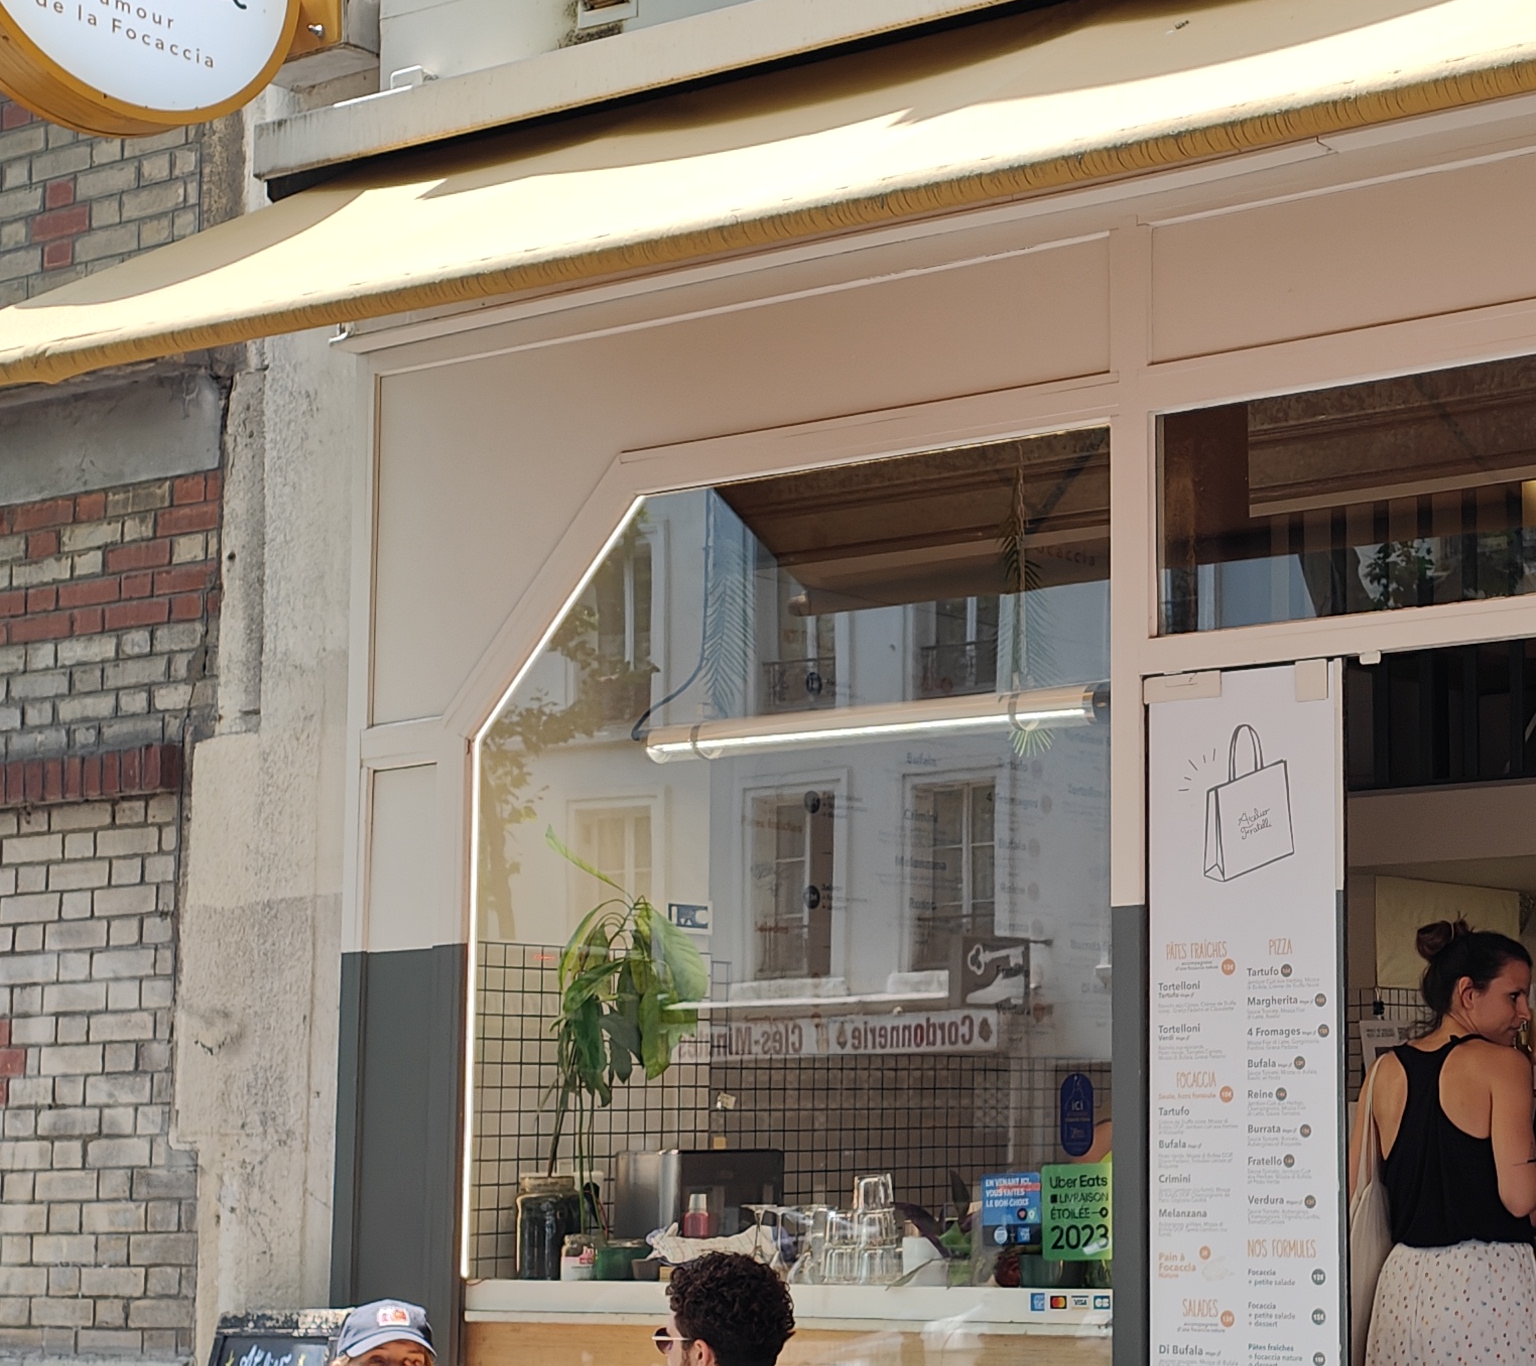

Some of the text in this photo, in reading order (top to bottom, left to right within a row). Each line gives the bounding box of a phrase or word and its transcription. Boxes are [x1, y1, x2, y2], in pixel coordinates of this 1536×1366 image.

[77, 4, 98, 27] la
[111, 18, 216, 69] Focaccia
[1166, 938, 1228, 961] PÂTES FRAÎCHES
[1269, 938, 1292, 956] PIZZA
[1247, 966, 1279, 977] Tartufo
[1158, 980, 1200, 991] Tortelloni
[1247, 996, 1298, 1008] Margherita
[1158, 1023, 1200, 1034] Tortelloni
[1247, 1027, 1253, 1036] 4
[1255, 1027, 1301, 1038] Fromages
[1247, 1059, 1276, 1068] Bufala
[1247, 1090, 1273, 1099] Reine
[1158, 1105, 1190, 1116] Tartufo
[1247, 1124, 1281, 1134] Burrata
[1158, 1139, 1187, 1149] Bufala
[1247, 1156, 1282, 1166] Fratello
[1049, 1174, 1108, 1190] Uber Eats
[1158, 1174, 1191, 1183] Crimini
[1248, 1195, 1284, 1205] Verdura
[1158, 1208, 1208, 1218] Melanzana
[1050, 1224, 1109, 1250] 2023
[1247, 1239, 1316, 1259] NOS FORMULES
[1158, 1252, 1178, 1262] Pain
[1158, 1262, 1197, 1273] Focaccia
[1248, 1268, 1276, 1277] Focaccia
[1254, 1278, 1296, 1287] petite salade
[1182, 1299, 1218, 1318] SALADES
[1248, 1301, 1276, 1310] Focaccia
[1254, 1312, 1296, 1321] petite salade
[1254, 1320, 1278, 1328] dessert
[1159, 1344, 1203, 1356] Di Bufala
[1254, 1353, 1281, 1362] focaccia
